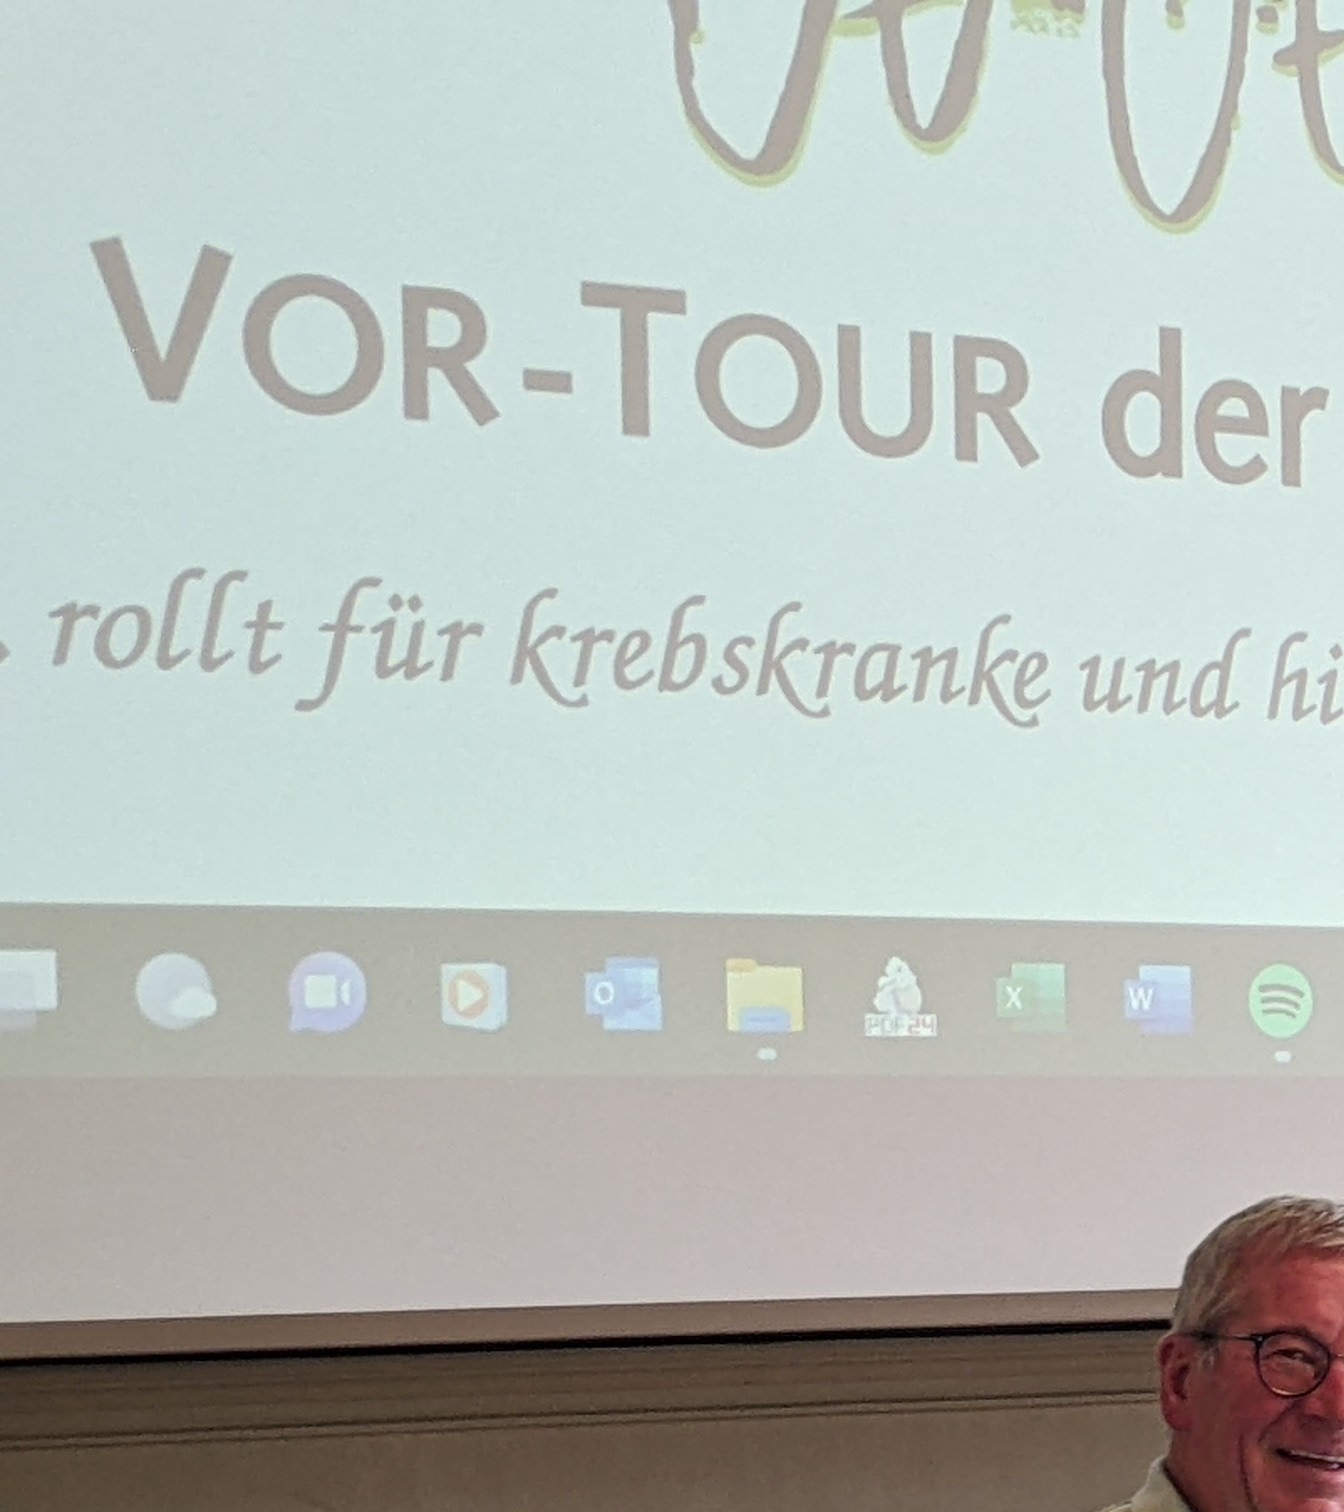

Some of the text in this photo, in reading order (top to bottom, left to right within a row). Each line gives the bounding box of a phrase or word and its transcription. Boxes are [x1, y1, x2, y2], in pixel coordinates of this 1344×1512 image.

[88, 235, 1041, 469] VOR-TOUR
[1100, 325, 1330, 489] der
[47, 566, 286, 676] rollt
[294, 576, 485, 713] für
[509, 587, 1052, 729] krebskranke
[1078, 627, 1253, 720] und
[1127, 985, 1155, 1012] W
